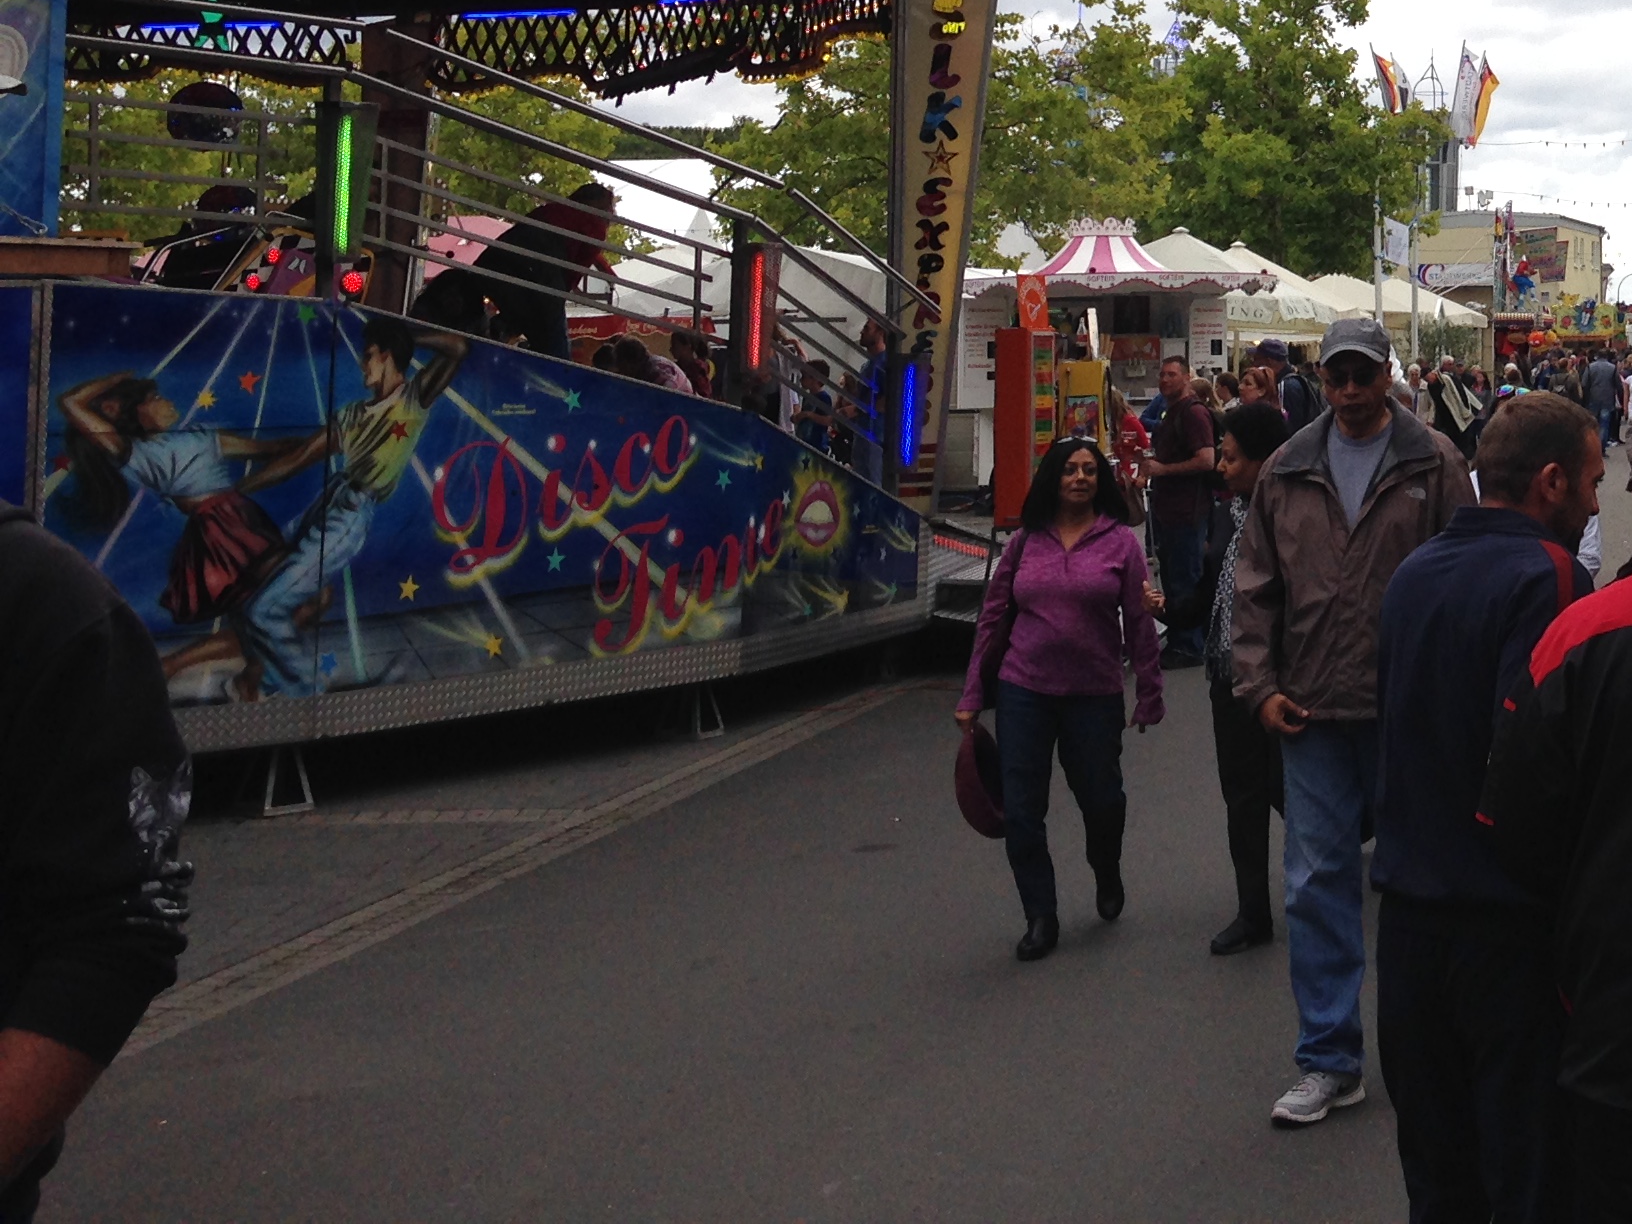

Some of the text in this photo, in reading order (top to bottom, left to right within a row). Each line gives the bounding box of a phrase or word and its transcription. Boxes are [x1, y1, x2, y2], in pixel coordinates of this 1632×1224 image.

[911, 177, 953, 426] EXPRE
[432, 414, 693, 574] Disco
[594, 496, 785, 653] Time
